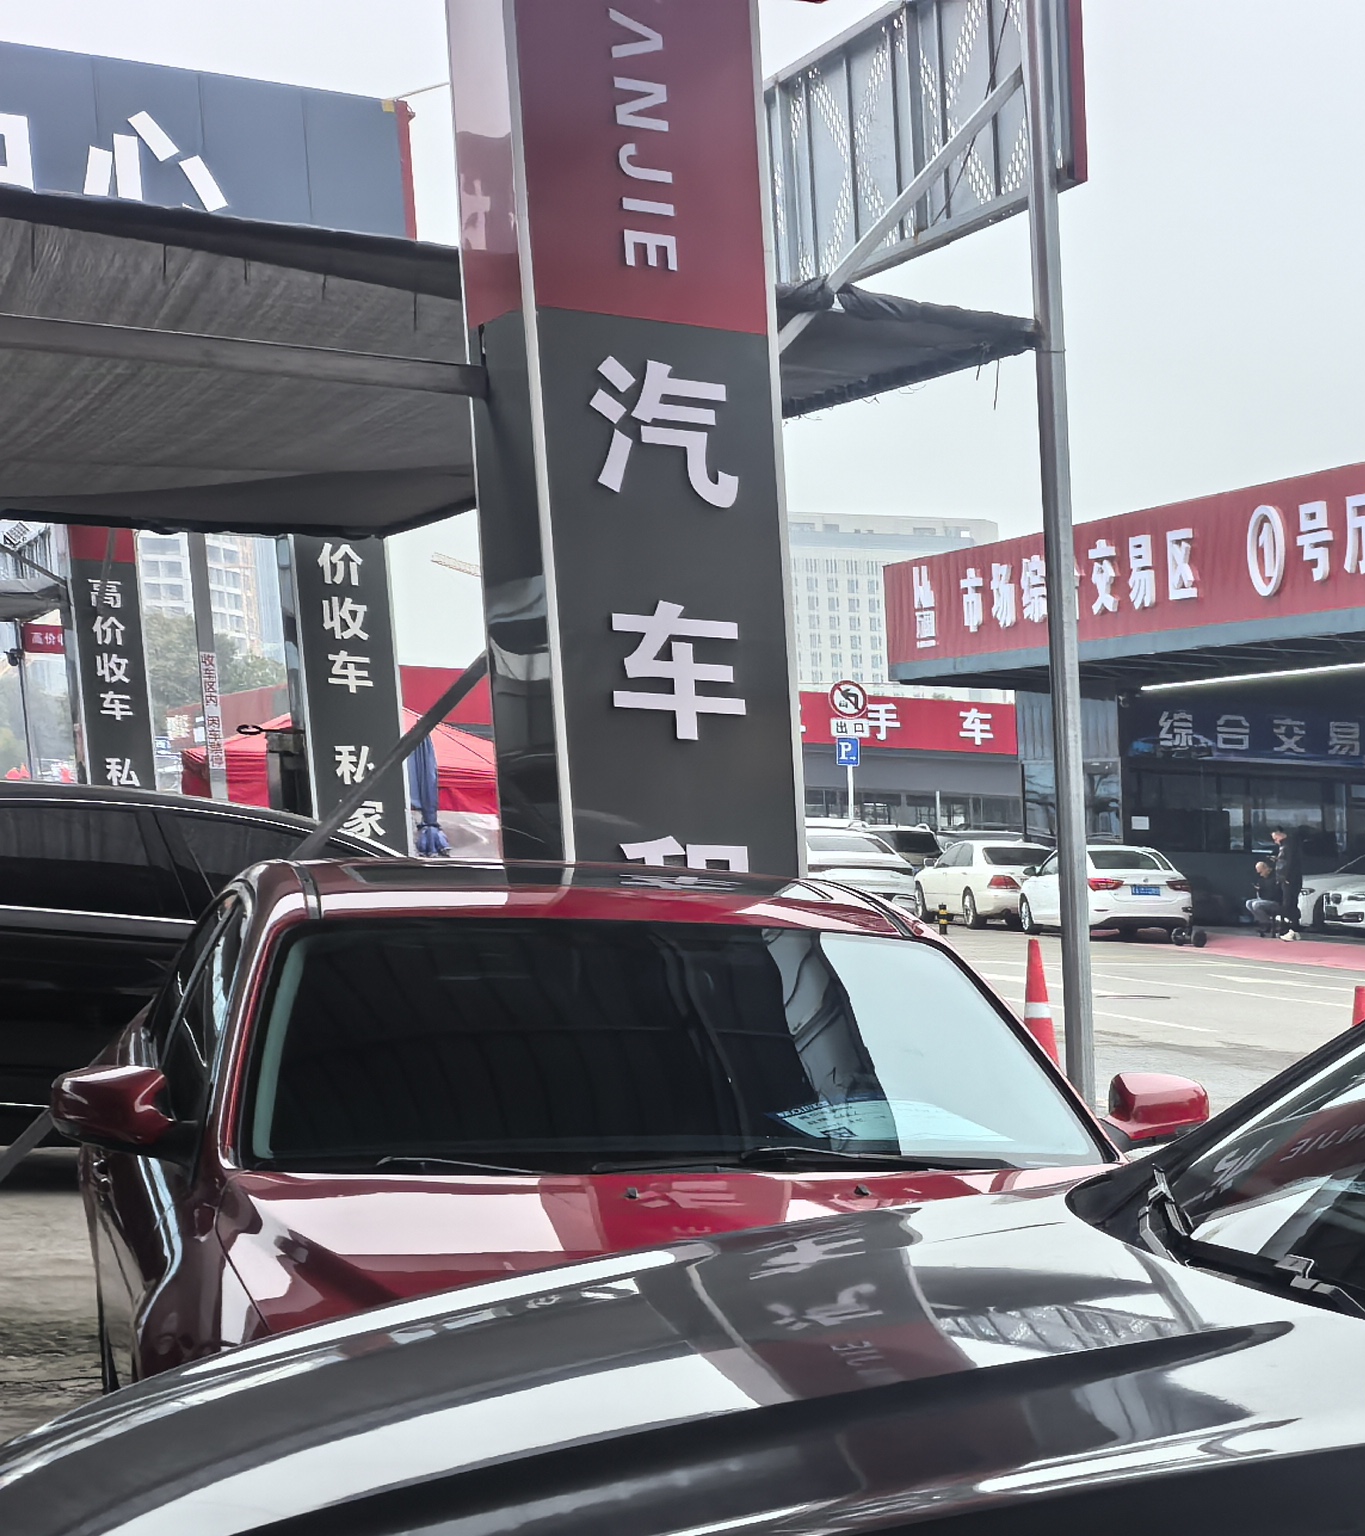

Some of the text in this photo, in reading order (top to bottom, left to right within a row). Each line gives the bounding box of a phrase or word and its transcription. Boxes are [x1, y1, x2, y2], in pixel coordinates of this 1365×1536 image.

[316, 542, 374, 694] 价收车
[960, 527, 1198, 634] 市场综交易区
[87, 578, 141, 788] 高价收车 私
[836, 721, 865, 734] 出口
[839, 741, 852, 760] P
